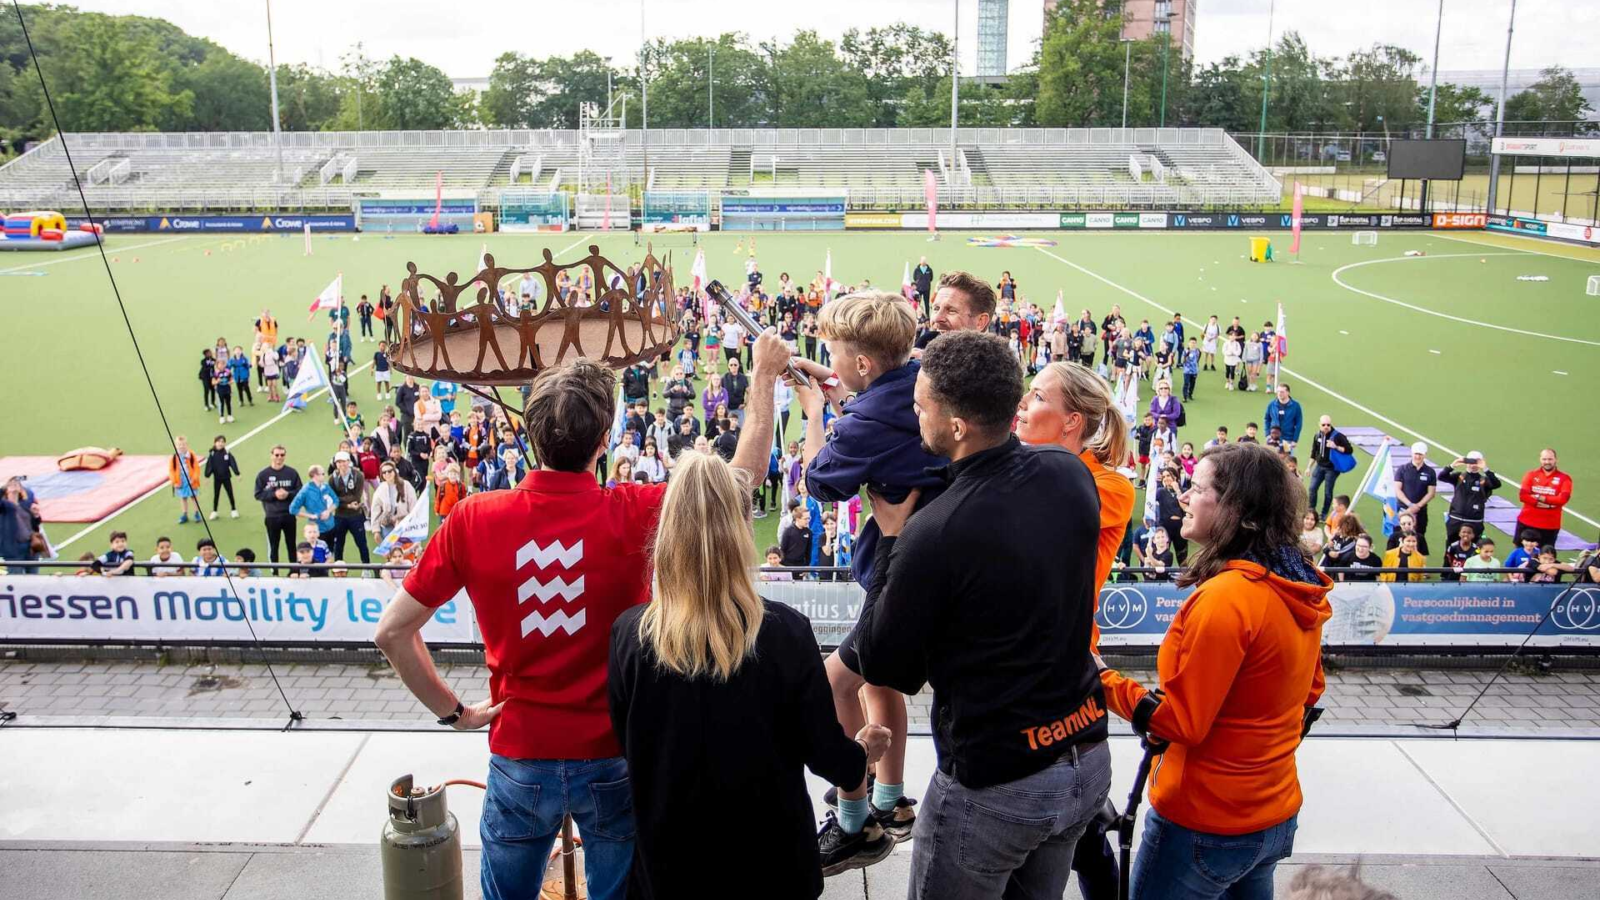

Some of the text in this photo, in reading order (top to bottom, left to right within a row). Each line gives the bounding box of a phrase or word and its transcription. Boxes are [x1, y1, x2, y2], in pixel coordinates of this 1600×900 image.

[173, 218, 200, 228] Crowe
[275, 218, 302, 228] Crowe
[1436, 214, 1486, 227] D-SIGN
[0, 584, 139, 620] iessen
[346, 588, 457, 624] lee
[1403, 597, 1515, 610] Persoonlijkheid in
[1401, 611, 1542, 625] vastgoedmanagement
[1020, 696, 1105, 750] TeamNL
